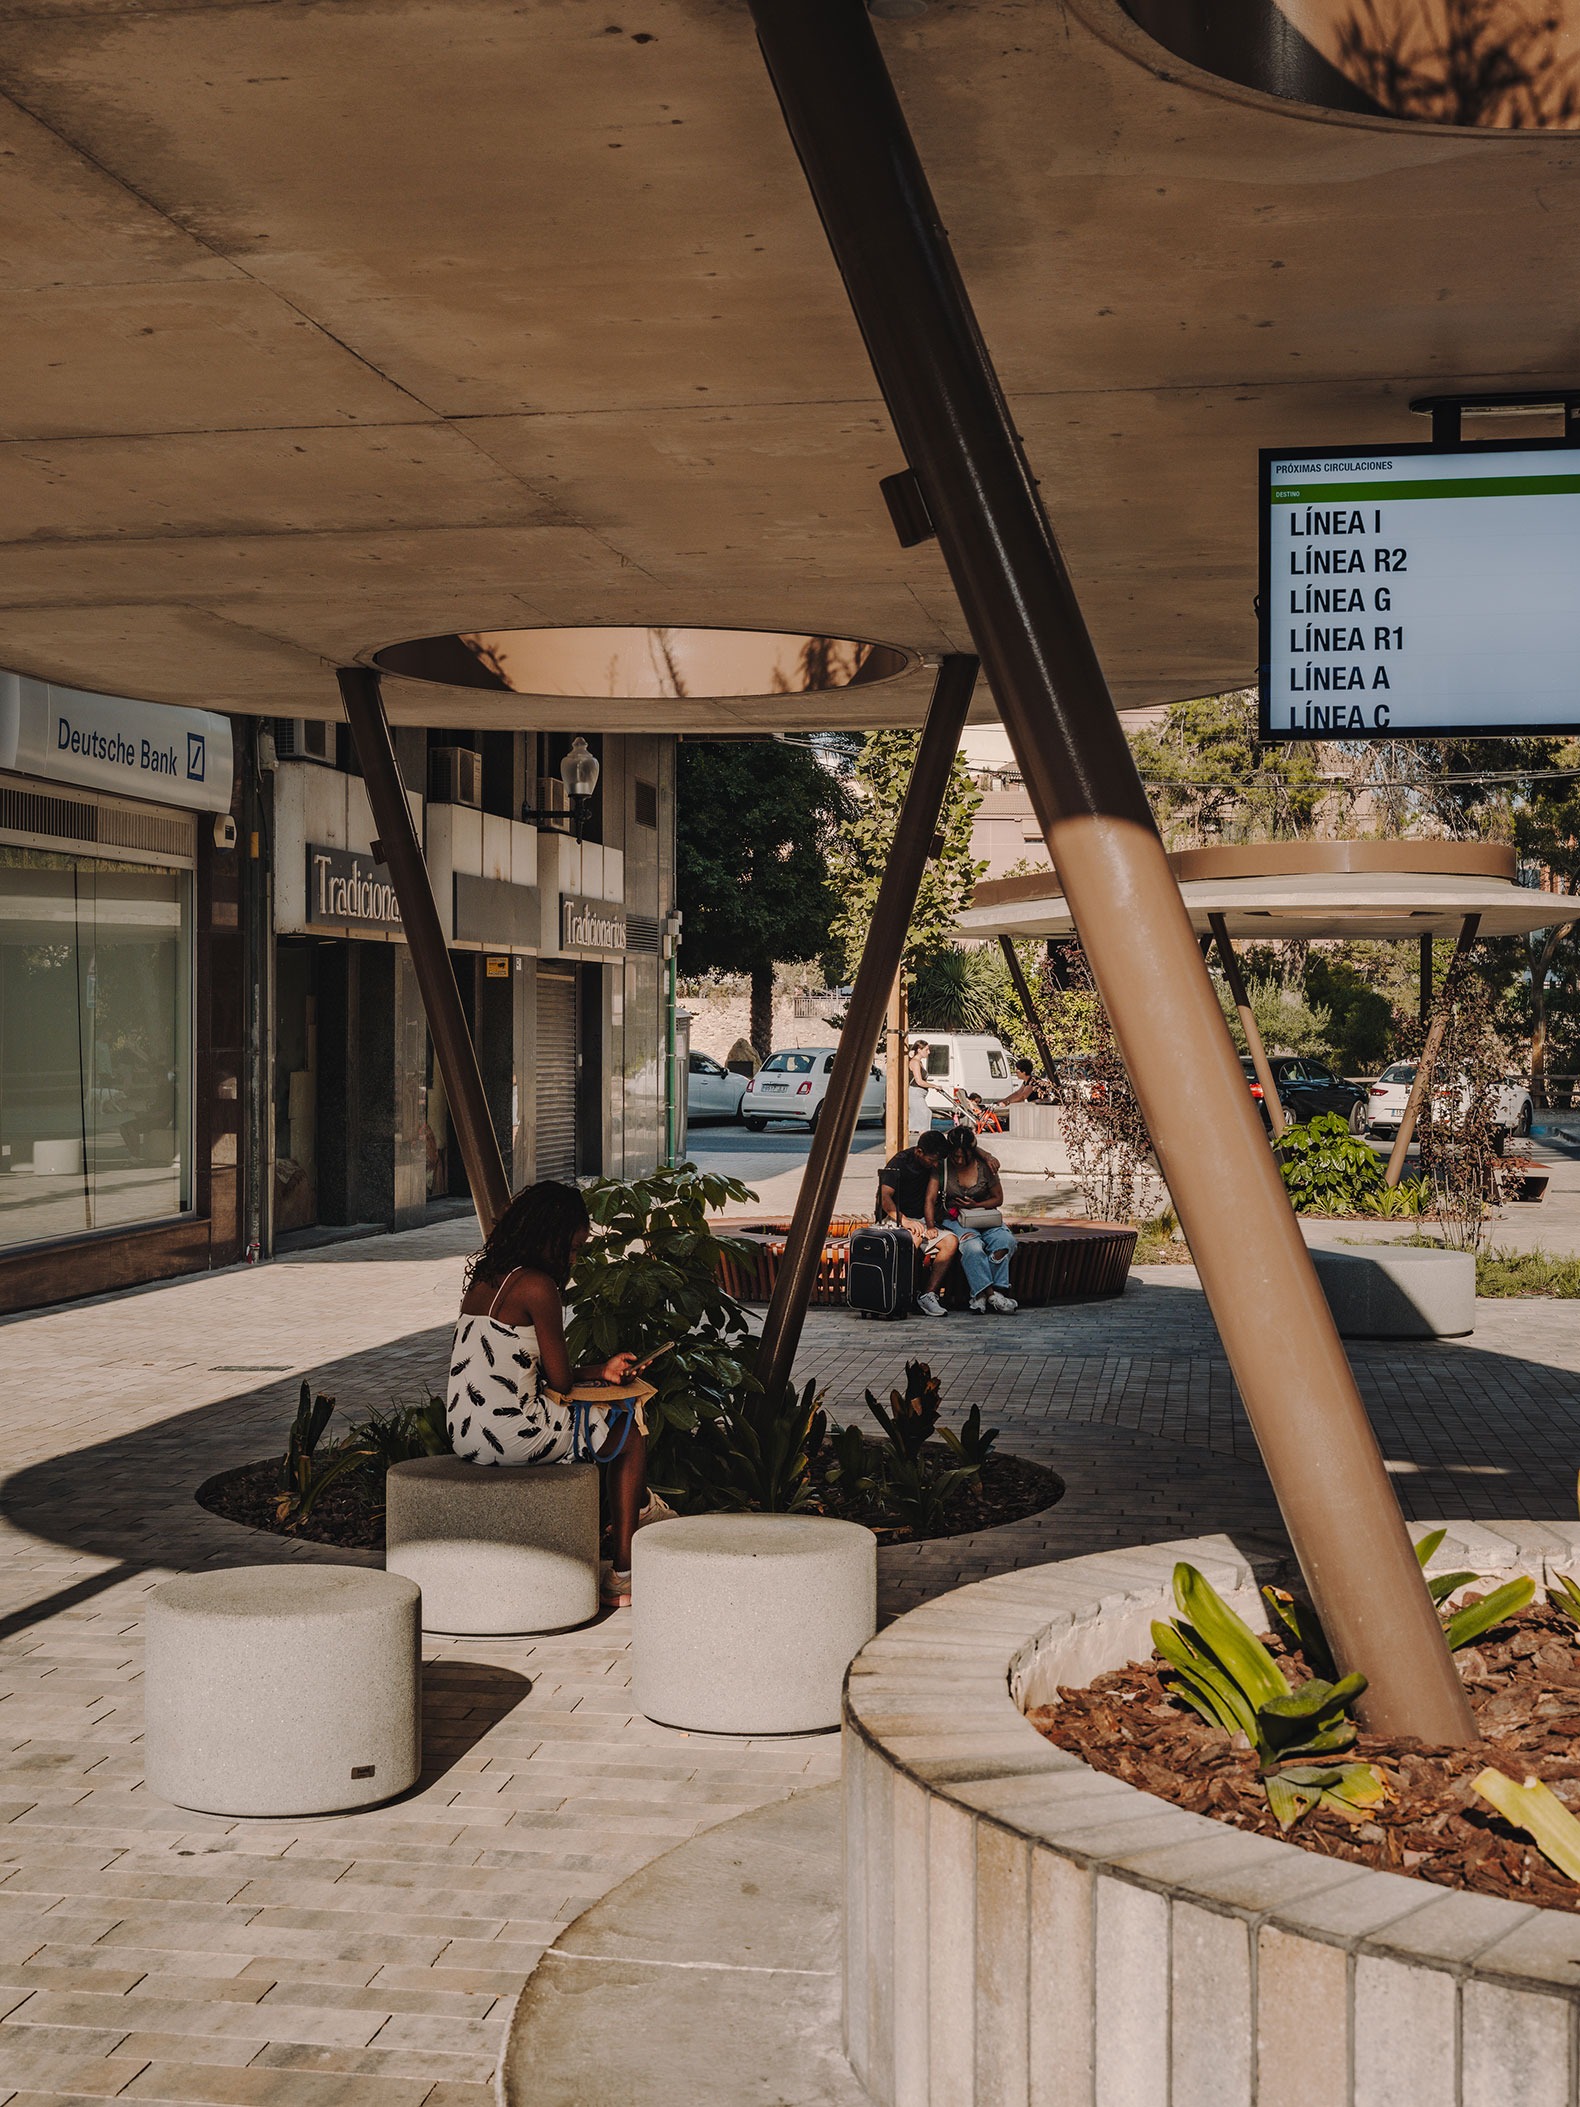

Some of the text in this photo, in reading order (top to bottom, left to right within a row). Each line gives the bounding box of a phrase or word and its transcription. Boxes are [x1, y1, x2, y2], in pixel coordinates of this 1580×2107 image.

[1276, 461, 1393, 474] PRÓXIMAS CIRCULACIONES
[1291, 506, 1381, 537] LÍNEA I
[1291, 545, 1407, 575] LÍNEA R2
[1291, 584, 1391, 614] LÍNEA G
[1291, 623, 1403, 653] LÍNEA R1
[1291, 661, 1391, 692] LÍNEA A
[1291, 701, 1390, 728] LÍNEA C
[58, 717, 178, 777] Deutsche Bank
[564, 900, 627, 950] Tradicionarius
